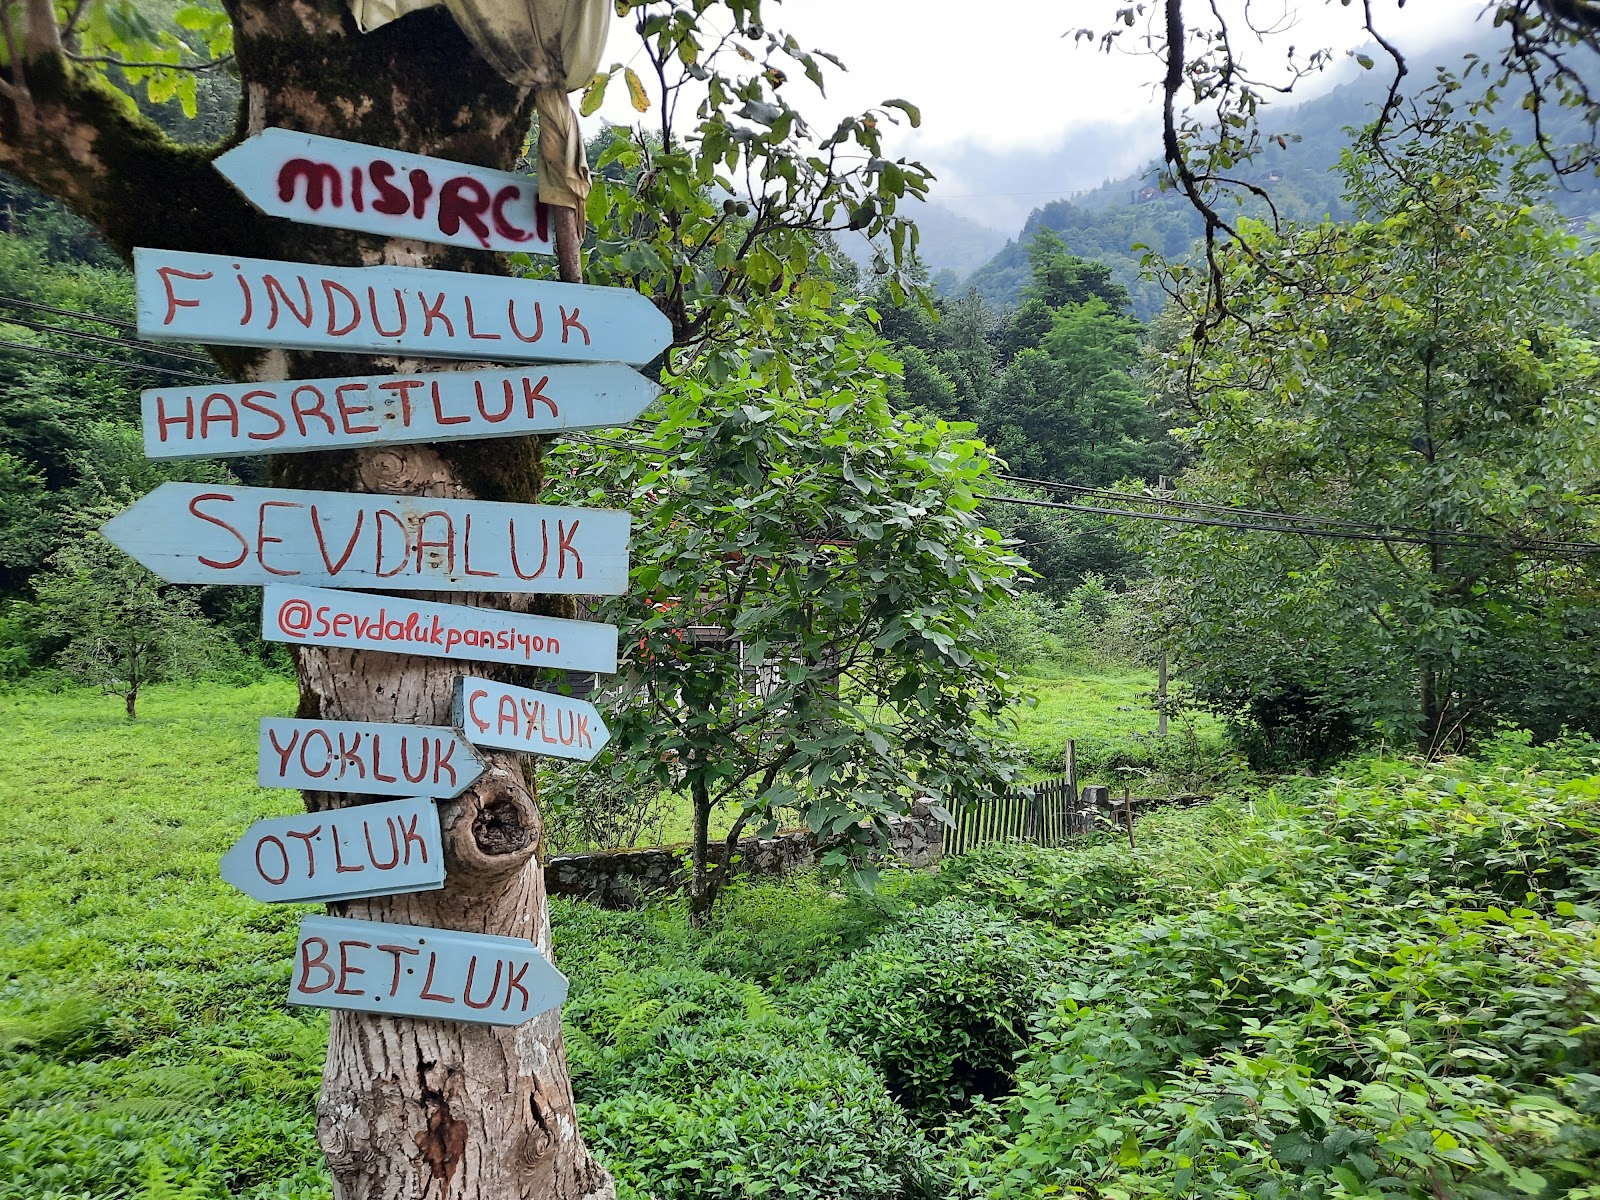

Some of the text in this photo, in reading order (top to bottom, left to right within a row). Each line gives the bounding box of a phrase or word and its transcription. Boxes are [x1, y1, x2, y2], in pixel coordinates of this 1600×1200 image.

[157, 375, 559, 442] HASRETLUK
[188, 493, 585, 580] SEVDALUK
[469, 689, 593, 749] ÇAYLUK
[268, 728, 457, 787] YOKLUK
[255, 813, 428, 885] OTLUK
[296, 936, 529, 1012] BETLUK
